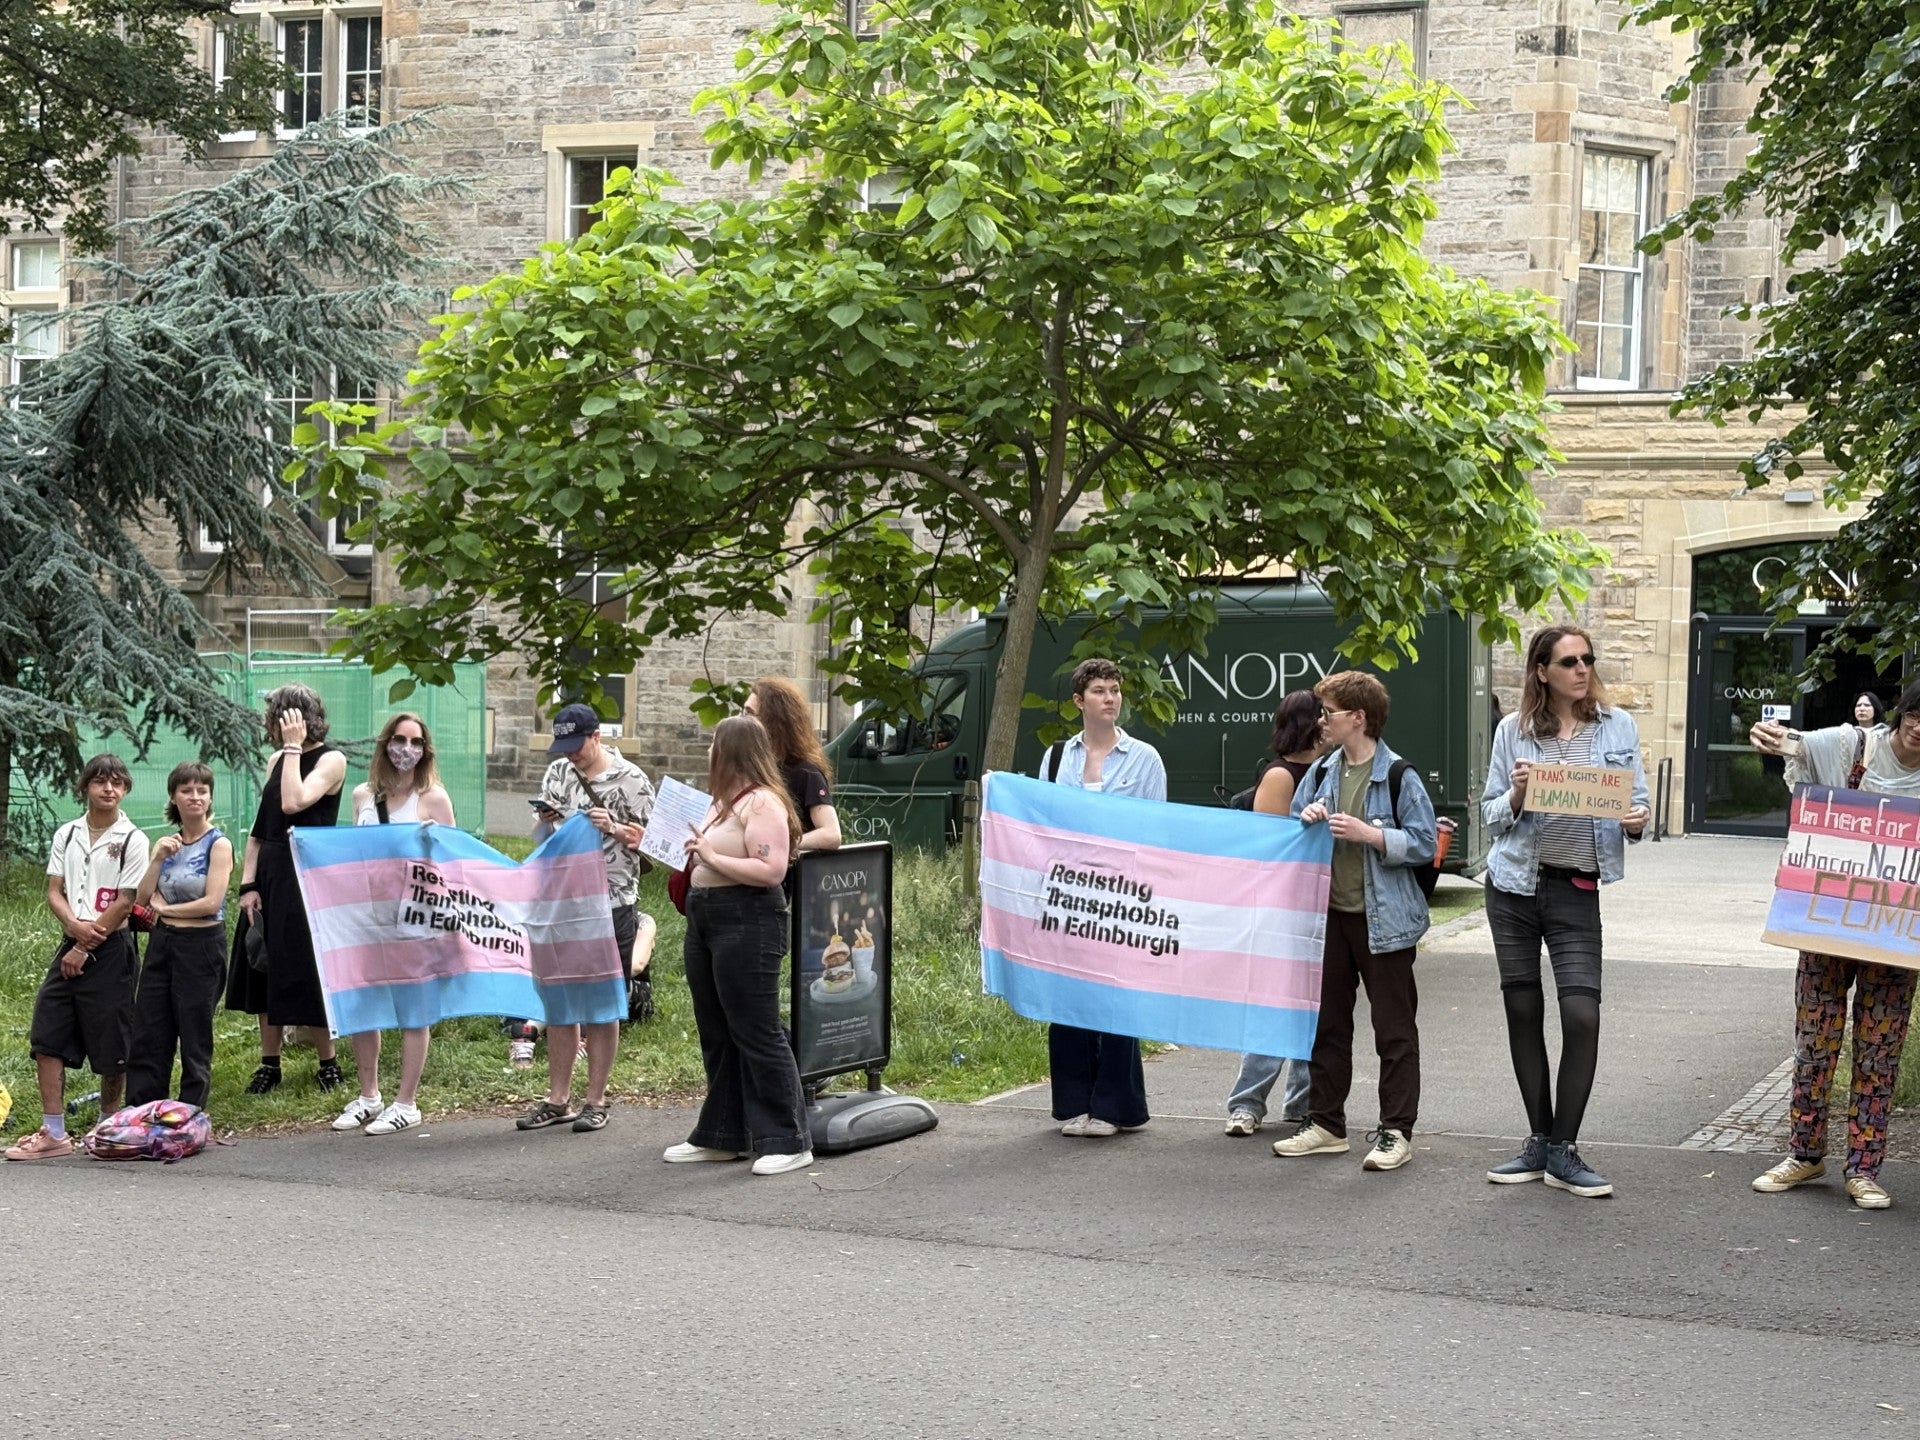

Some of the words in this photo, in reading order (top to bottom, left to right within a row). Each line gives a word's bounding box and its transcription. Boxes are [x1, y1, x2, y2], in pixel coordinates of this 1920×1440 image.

[1157, 652, 1342, 700] ANOPY
[1724, 687, 1776, 700] CANOPY
[1207, 712, 1216, 723] &
[1221, 712, 1275, 723] COURTY
[1535, 769, 1564, 784] TRANS
[1567, 770, 1597, 784] RIGHTS
[1601, 773, 1621, 788] ARE
[1532, 788, 1580, 809] HUMAN
[1586, 796, 1622, 811] RIGHTS
[821, 870, 868, 892] CANOPY
[1050, 863, 1153, 903] Resisting
[1046, 886, 1179, 931] Transphobia
[1064, 916, 1180, 957] Edinburgh
